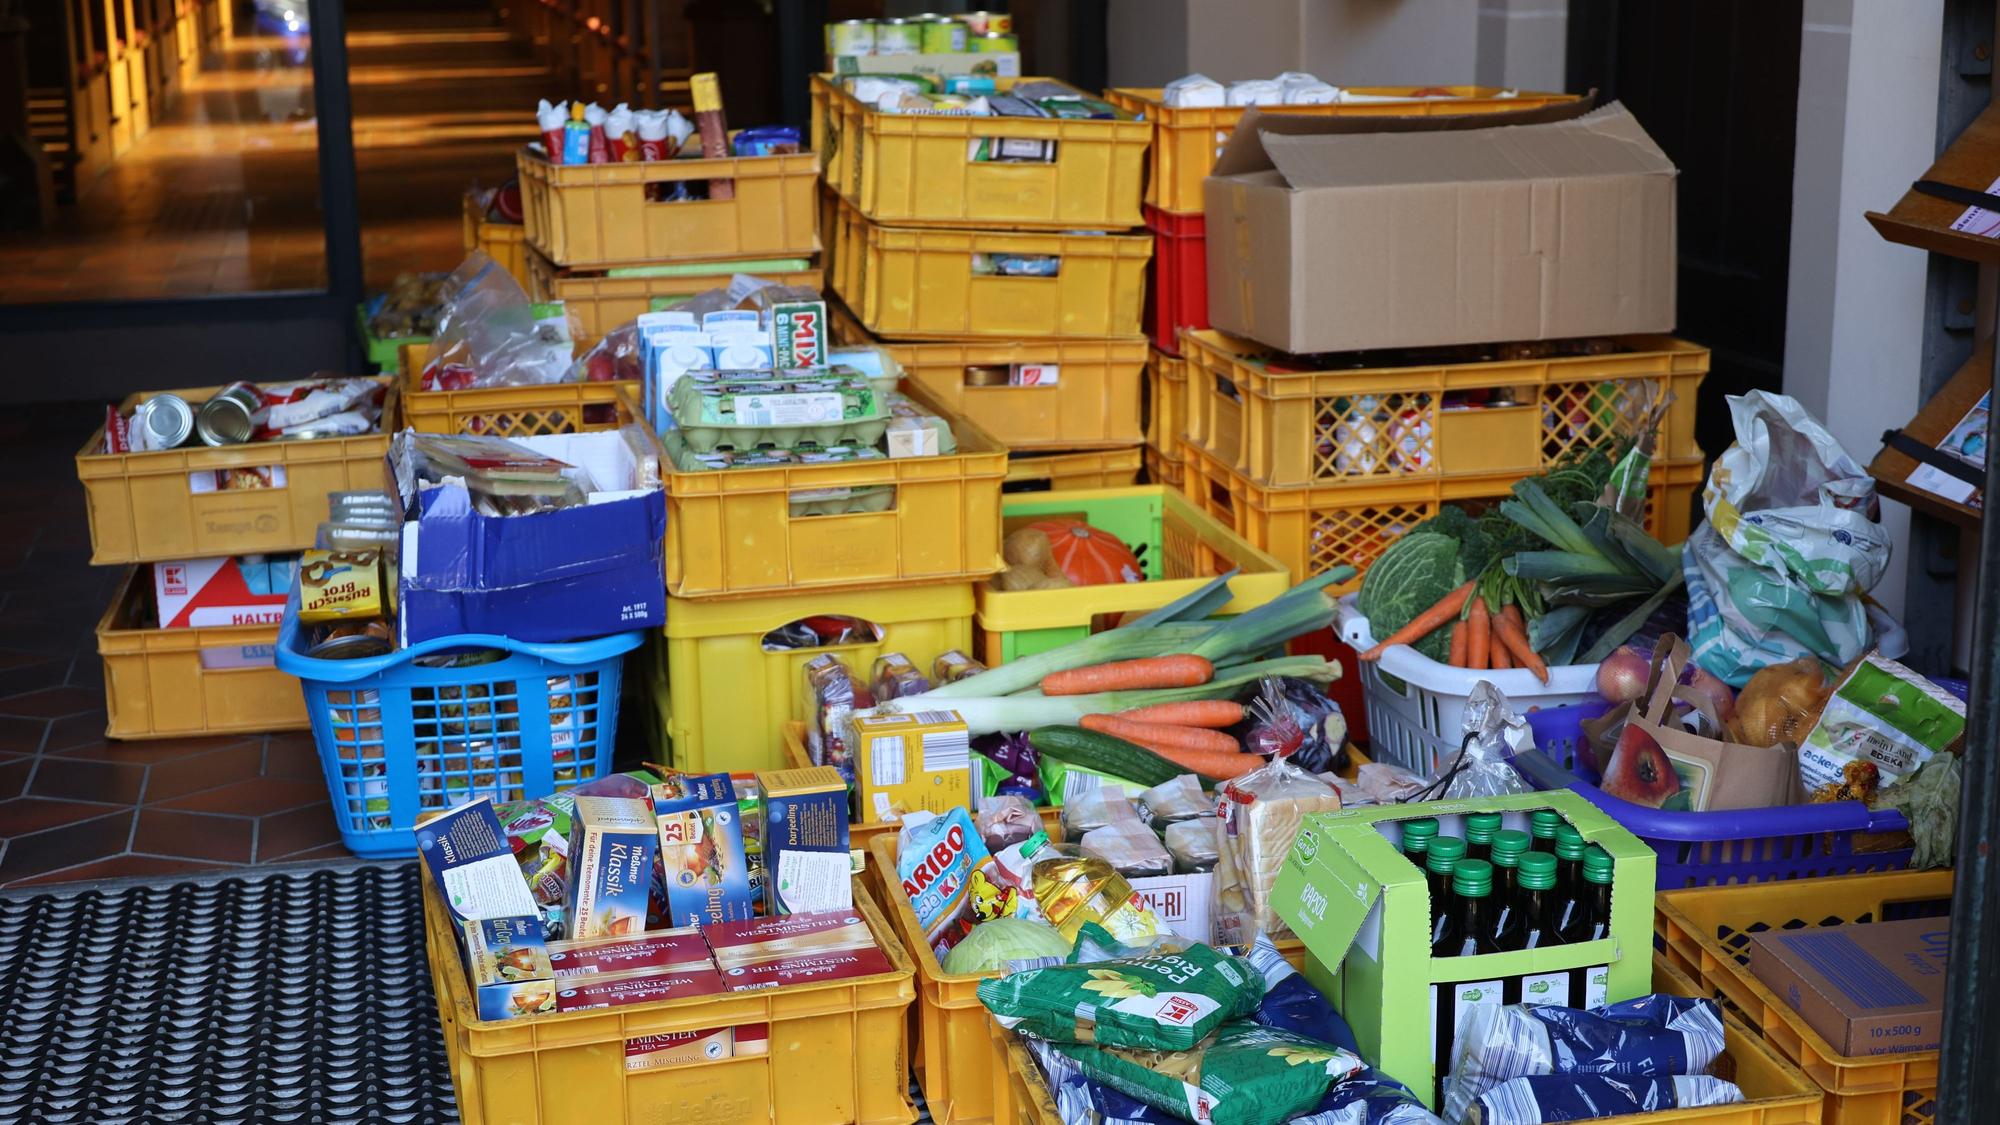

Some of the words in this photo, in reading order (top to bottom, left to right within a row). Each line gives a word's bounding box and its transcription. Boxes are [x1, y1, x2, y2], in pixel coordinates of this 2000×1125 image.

[776, 313, 789, 325] 6
[777, 325, 790, 368] MINI-PAC
[793, 313, 816, 369] MIX
[116, 411, 129, 452] PENN
[322, 581, 356, 598] Brot
[231, 612, 283, 626] HALTB
[1803, 749, 1844, 778] ackerg
[1871, 749, 1904, 769] EDEKA
[665, 823, 683, 843] 25
[787, 804, 798, 846] Darjeeling
[589, 832, 598, 844] Für
[437, 834, 457, 864] Klassik
[587, 845, 596, 863] deine
[605, 843, 628, 897] Klassik
[902, 824, 964, 898] ARIBO
[579, 907, 588, 916] 25
[705, 888, 724, 926] eeling
[1144, 890, 1181, 918] N-RI
[1299, 882, 1329, 921] RAPSÖL
[578, 916, 588, 937] Beutel
[736, 919, 838, 938] WESTMINSTER
[572, 942, 678, 958] WESTMINSTER
[751, 956, 859, 973] WESTMINSTER
[1111, 956, 1189, 985] Penne
[584, 978, 694, 996] WESTMINSTER
[626, 1029, 699, 1047] TMINSTER
[1870, 1026, 1883, 1038] 10
[1912, 1025, 1922, 1037] g
[640, 1043, 657, 1051] TEA
